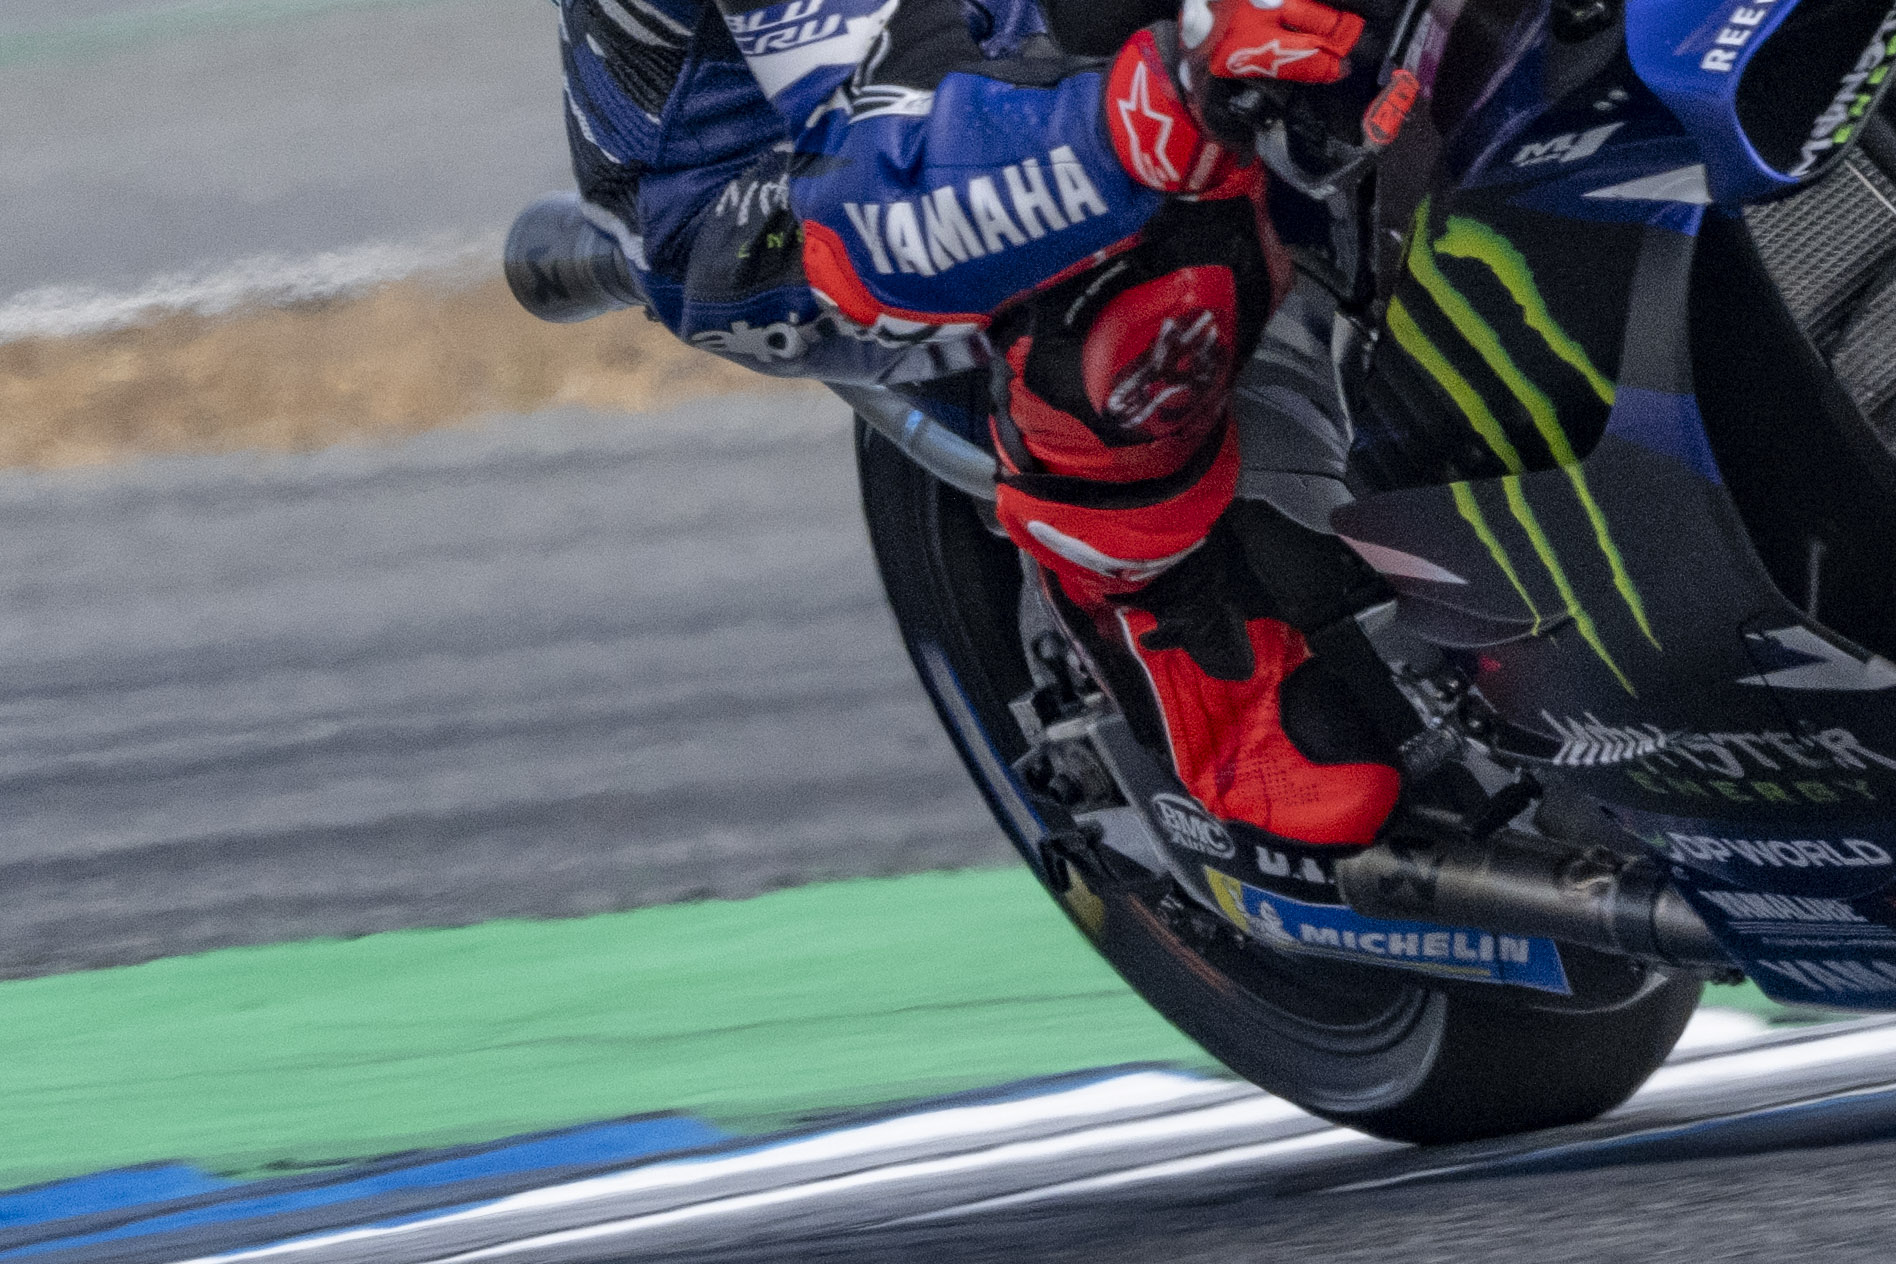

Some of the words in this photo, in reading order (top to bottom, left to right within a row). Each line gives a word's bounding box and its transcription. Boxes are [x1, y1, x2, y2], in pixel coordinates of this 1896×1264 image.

[843, 145, 1109, 278] YAMAHA
[1721, 838, 1893, 868] WORLD
[1300, 923, 1531, 965] MICHELIN
